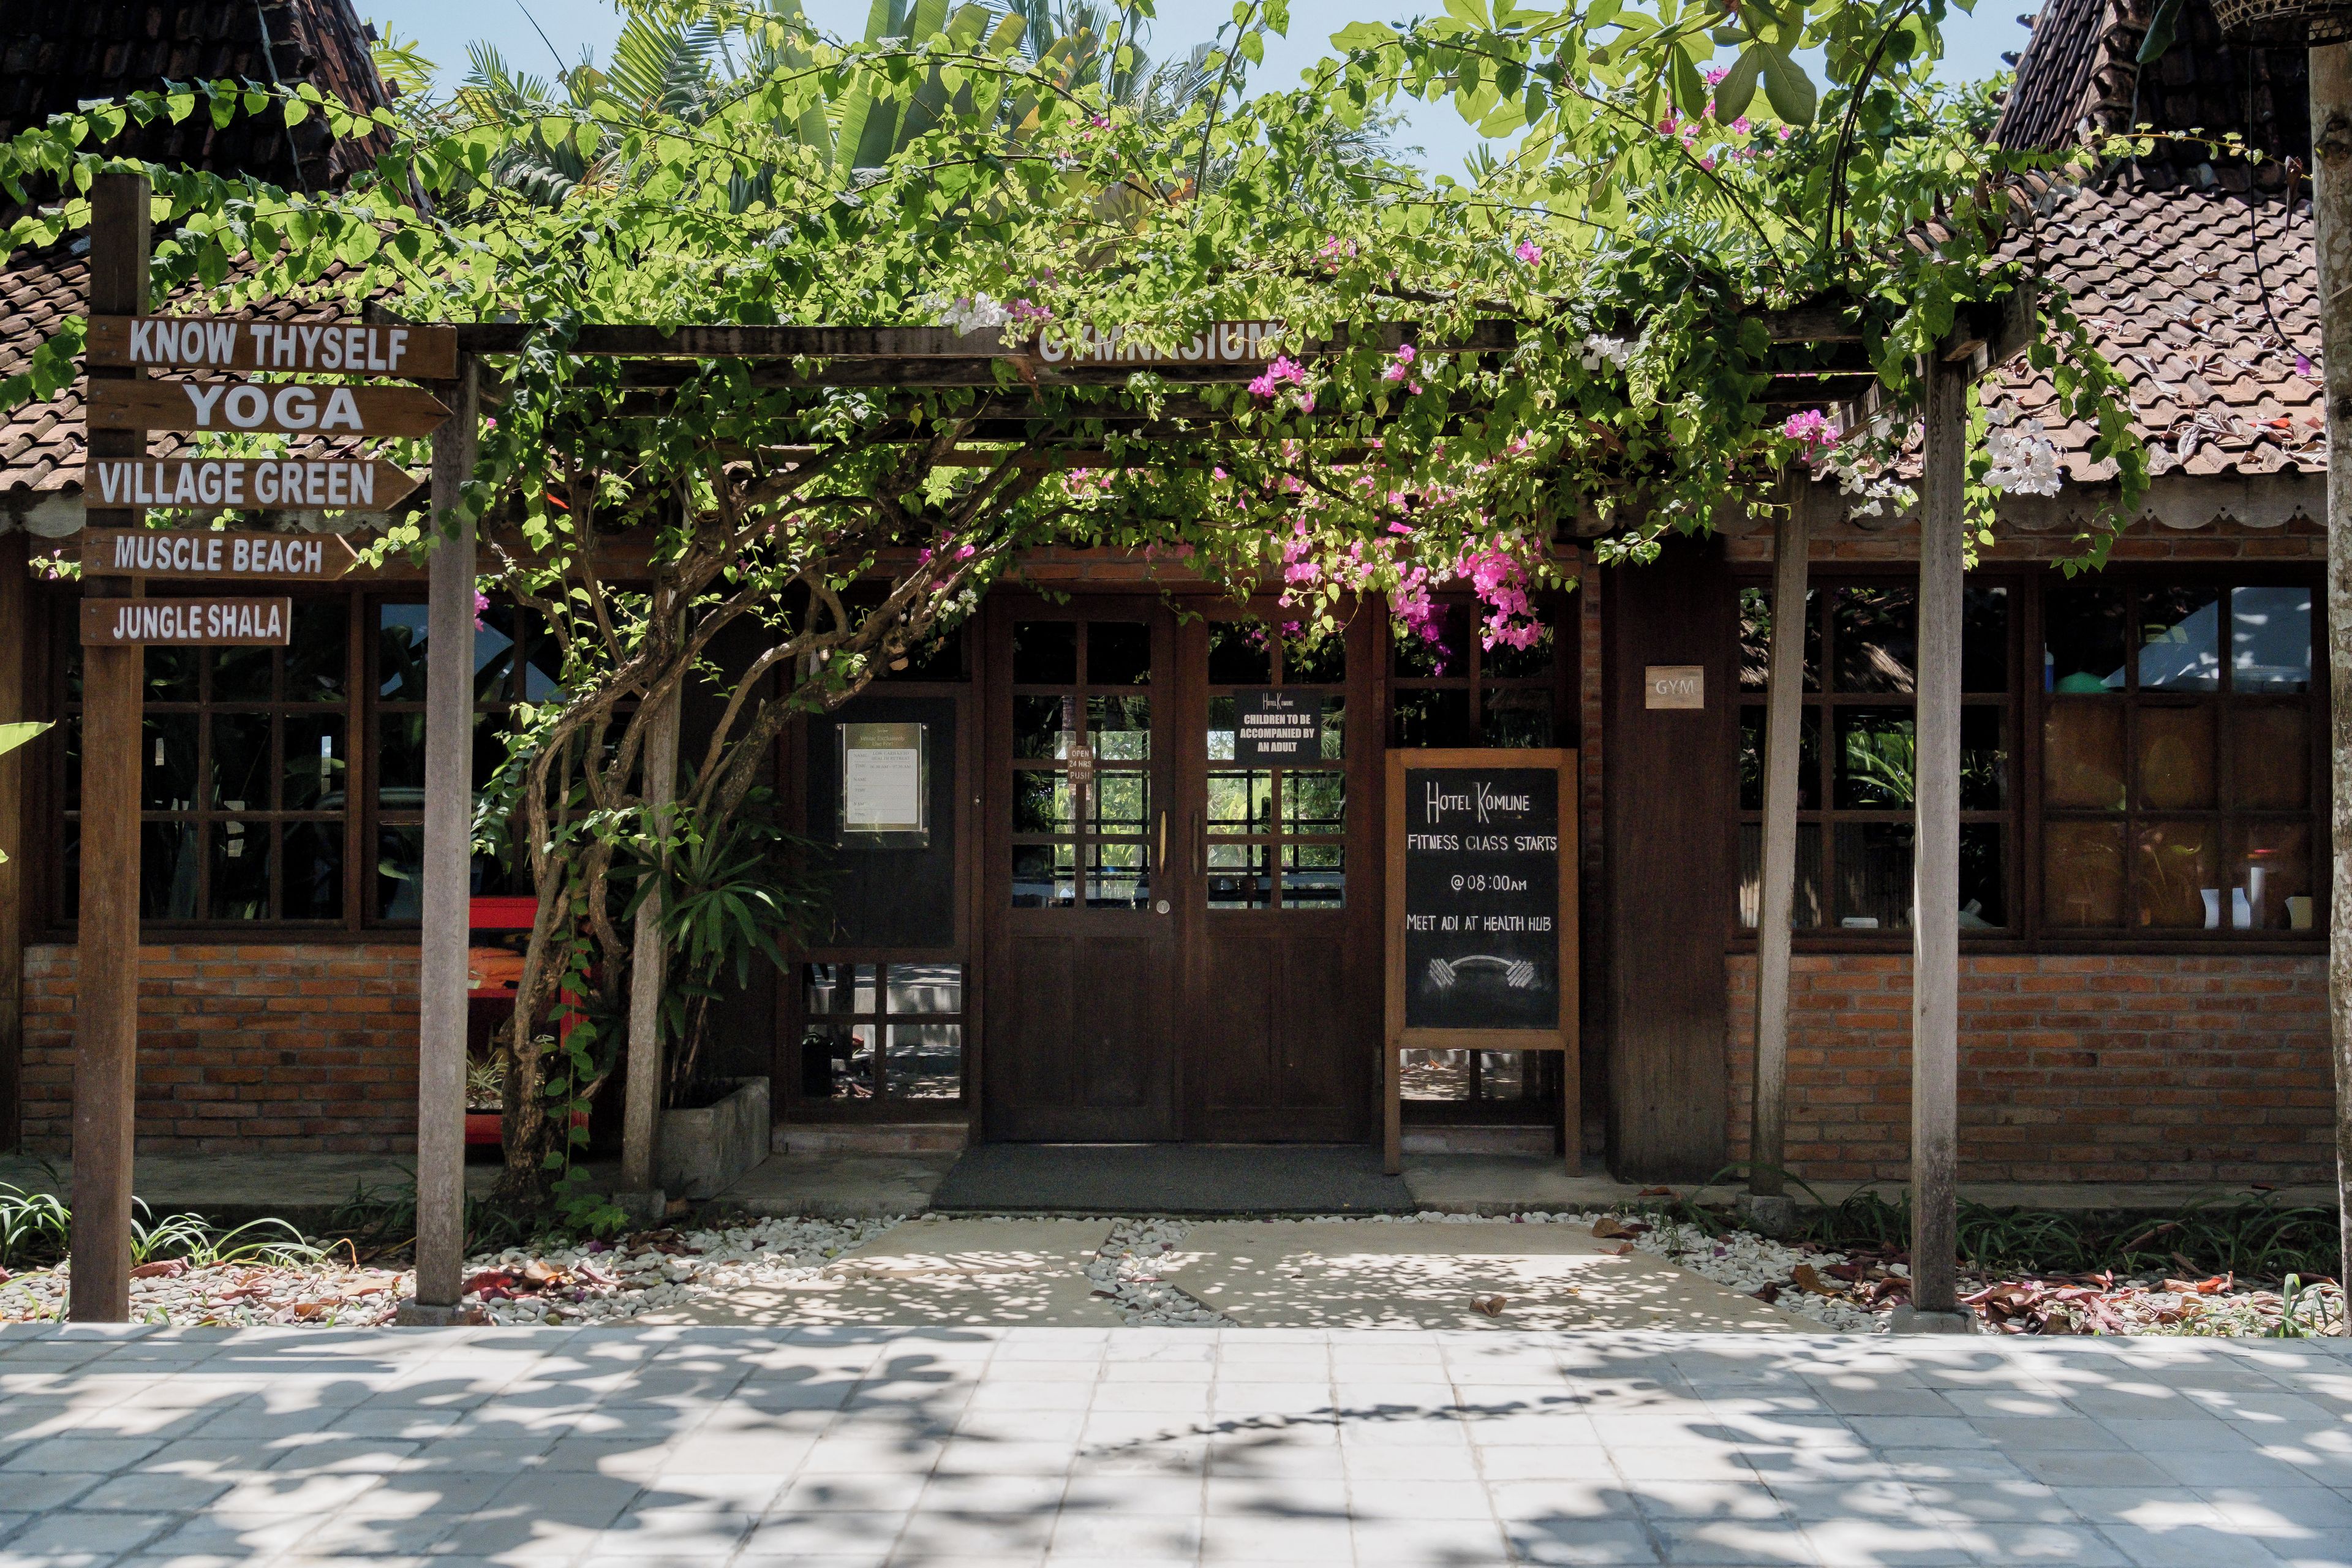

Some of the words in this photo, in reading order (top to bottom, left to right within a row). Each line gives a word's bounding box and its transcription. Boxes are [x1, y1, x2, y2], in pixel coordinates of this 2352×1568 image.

[130, 320, 237, 364] KNOW
[251, 325, 409, 371] THYSELF
[183, 383, 364, 429] YOGA
[98, 462, 244, 504] VILLAGE
[255, 462, 374, 505] GREEN
[115, 535, 223, 571] MUSCLE
[233, 538, 322, 573] BEACH
[113, 605, 202, 639] JUNGLE
[208, 604, 281, 638] SHALA
[1656, 680, 1694, 695] GYM
[1244, 714, 1286, 725] CHILDREN
[1287, 715, 1298, 724] TO
[1300, 714, 1311, 724] BE
[1240, 728, 1302, 739] ACCOMPANIED
[1303, 728, 1314, 738] BY
[1257, 742, 1269, 752] AN
[1271, 742, 1297, 752] ADULT
[1427, 782, 1471, 823] HOTEL
[1477, 782, 1530, 823] KOMUNE
[1408, 834, 1459, 850] FITNESS
[1465, 835, 1508, 851] CLASS
[1514, 835, 1558, 851] STARTS
[1407, 914, 1436, 930] MEET
[1441, 915, 1458, 930] ADI
[1465, 916, 1479, 930] AT
[1484, 916, 1524, 931] HEALTH
[1528, 916, 1551, 931] HUB
